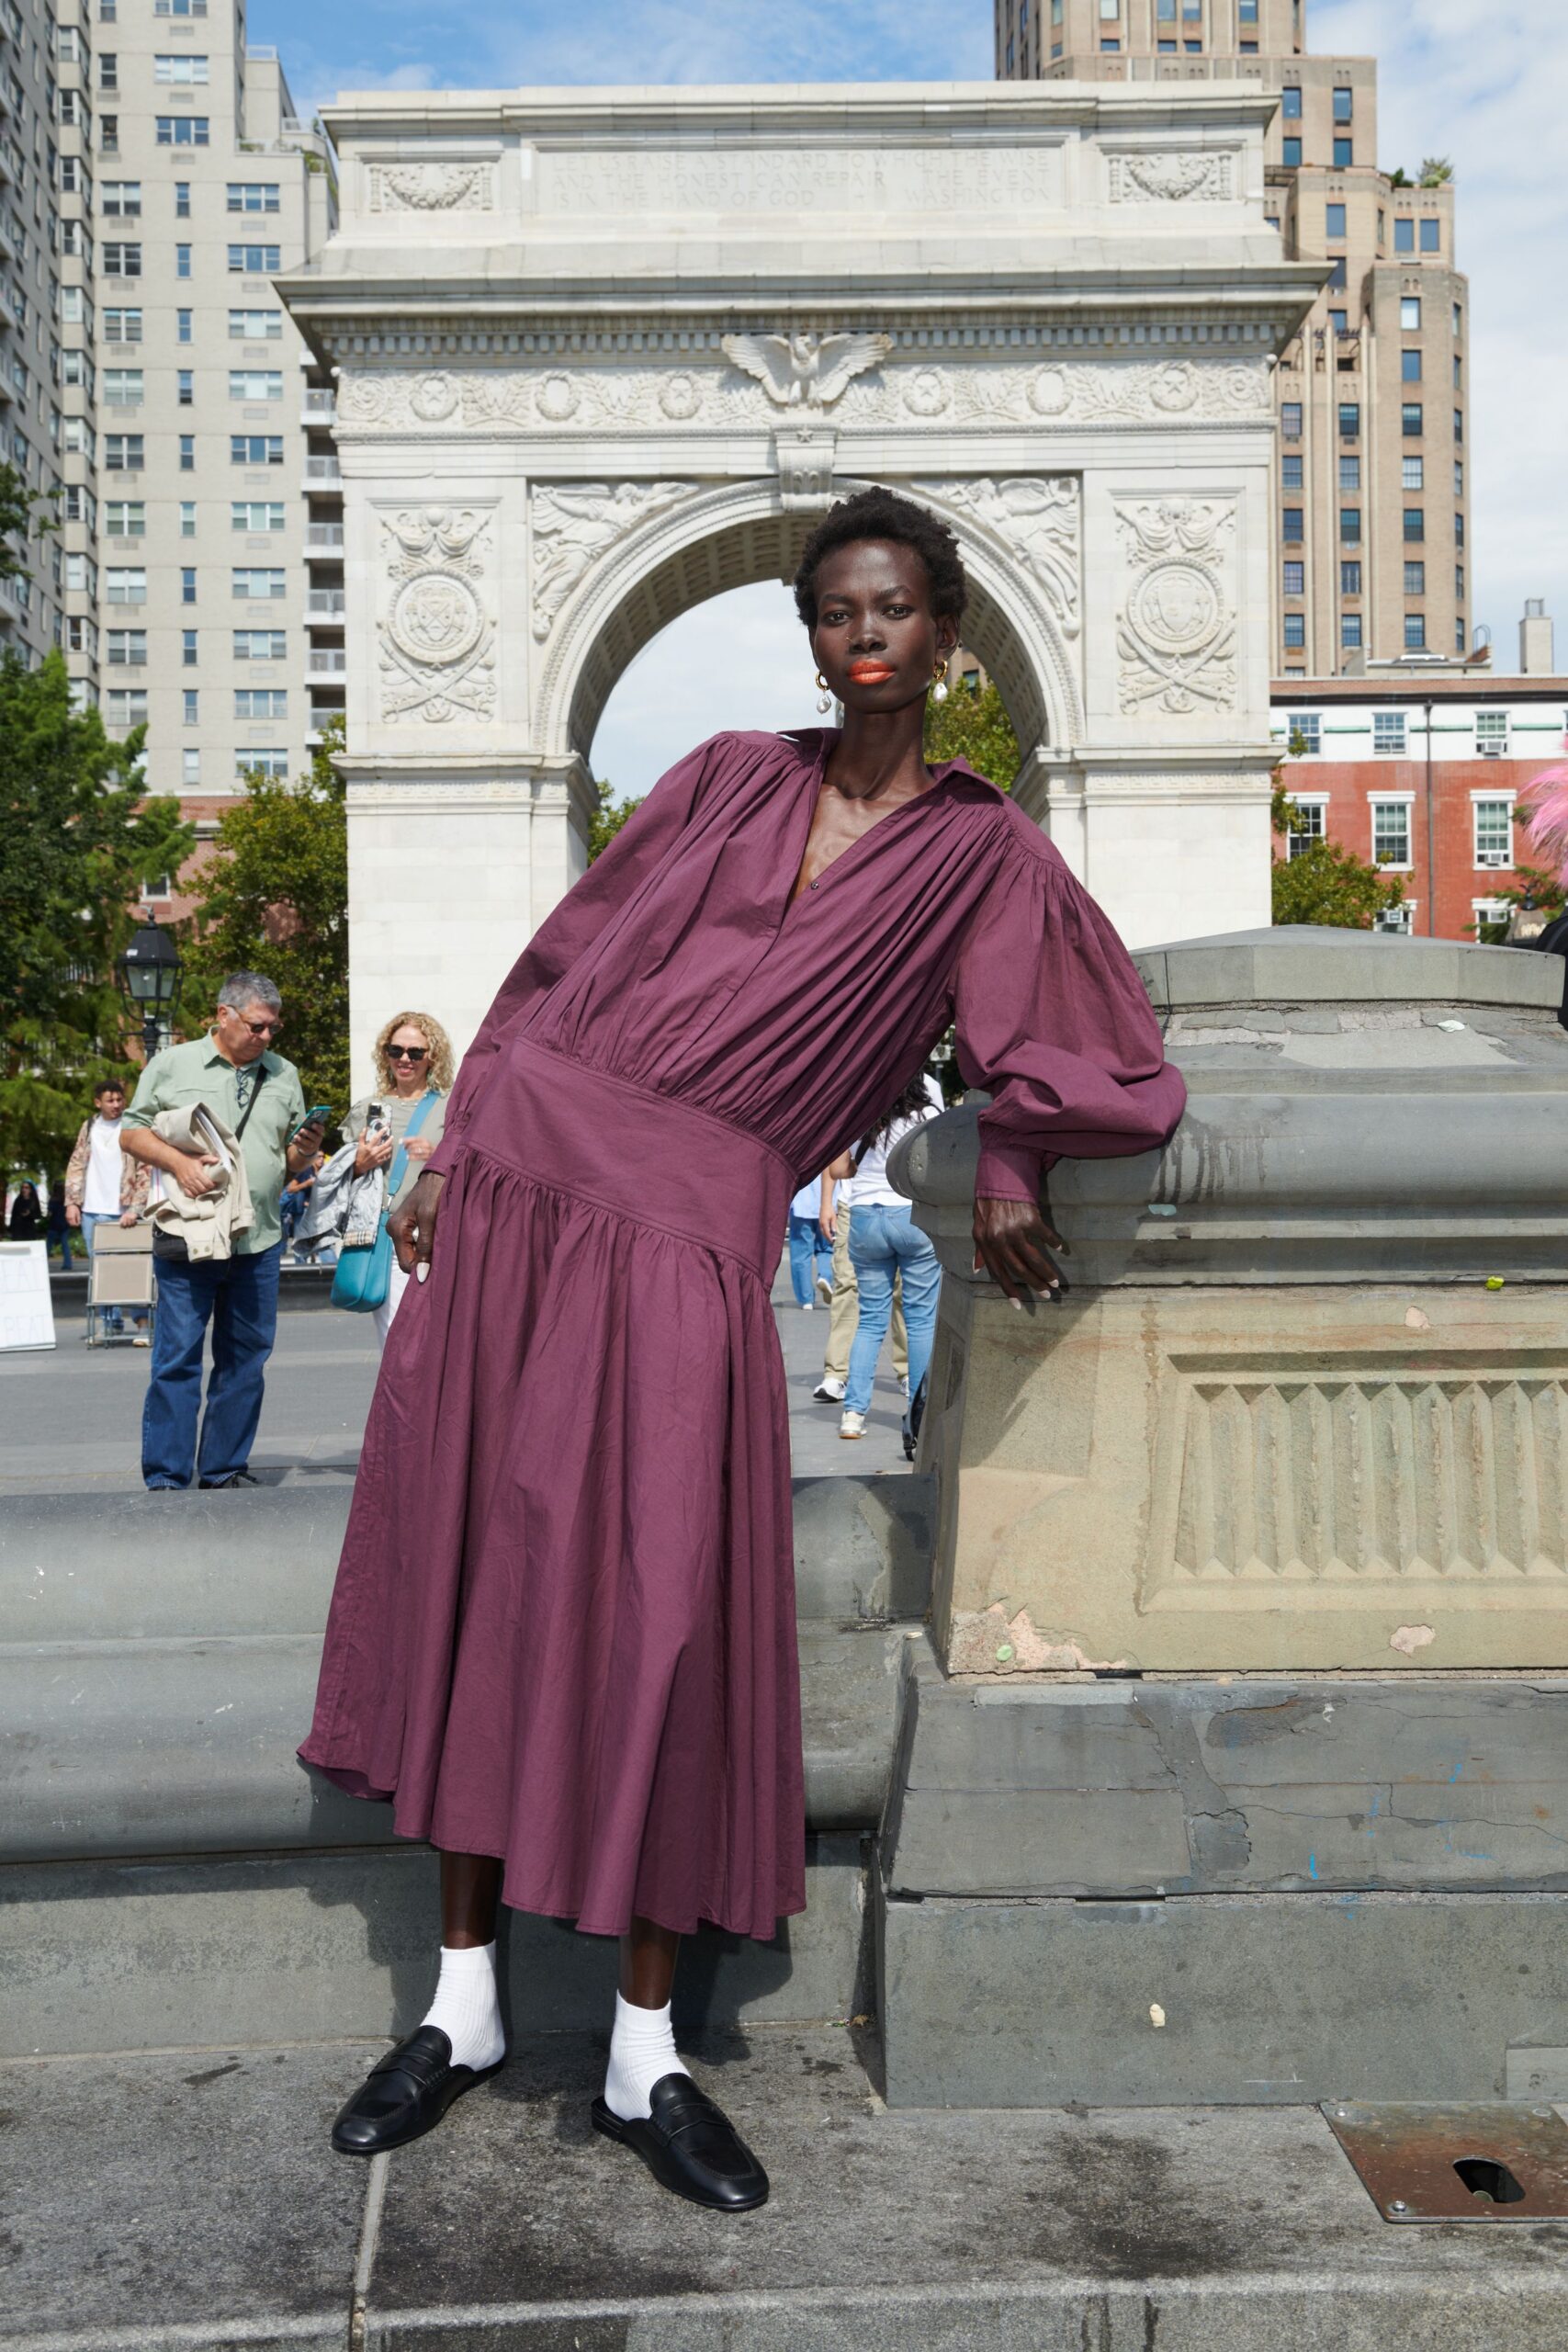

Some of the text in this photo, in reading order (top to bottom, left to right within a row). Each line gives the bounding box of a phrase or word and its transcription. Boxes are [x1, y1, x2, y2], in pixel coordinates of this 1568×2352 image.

[552, 152, 1048, 171] LET US RAISE A STANDARD TO WHICH THE WISE
[552, 170, 1050, 189] AND THE HONEST CAN REPAIR THE EVENT
[552, 190, 815, 209] IS IN THE HAND OF GOD
[905, 187, 1050, 204] WASHINGTON
